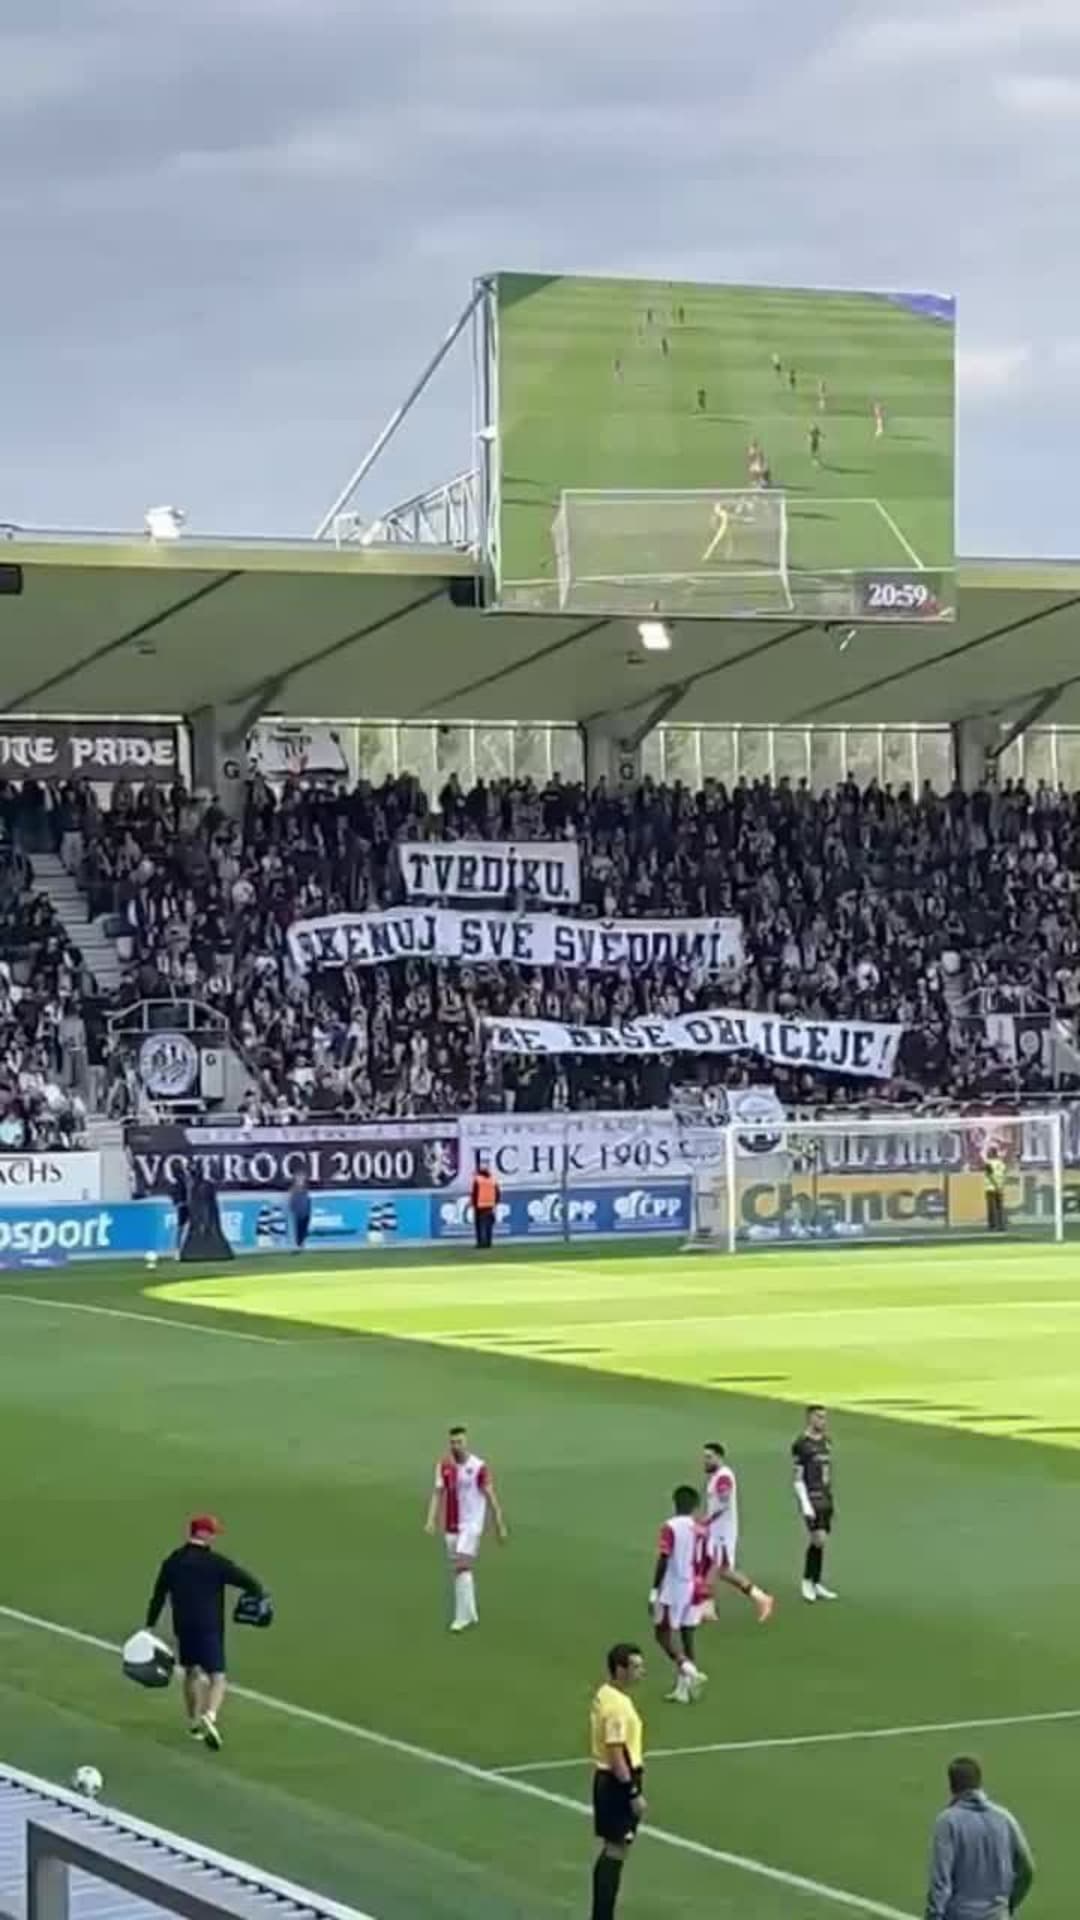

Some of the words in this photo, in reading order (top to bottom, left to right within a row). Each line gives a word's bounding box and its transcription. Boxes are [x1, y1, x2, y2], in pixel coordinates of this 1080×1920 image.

[869, 584, 927, 607] 20:59
[68, 736, 176, 768] PRIDE
[331, 1150, 414, 1182] 2000
[600, 1140, 671, 1170] 1905
[741, 1183, 946, 1224] Chance
